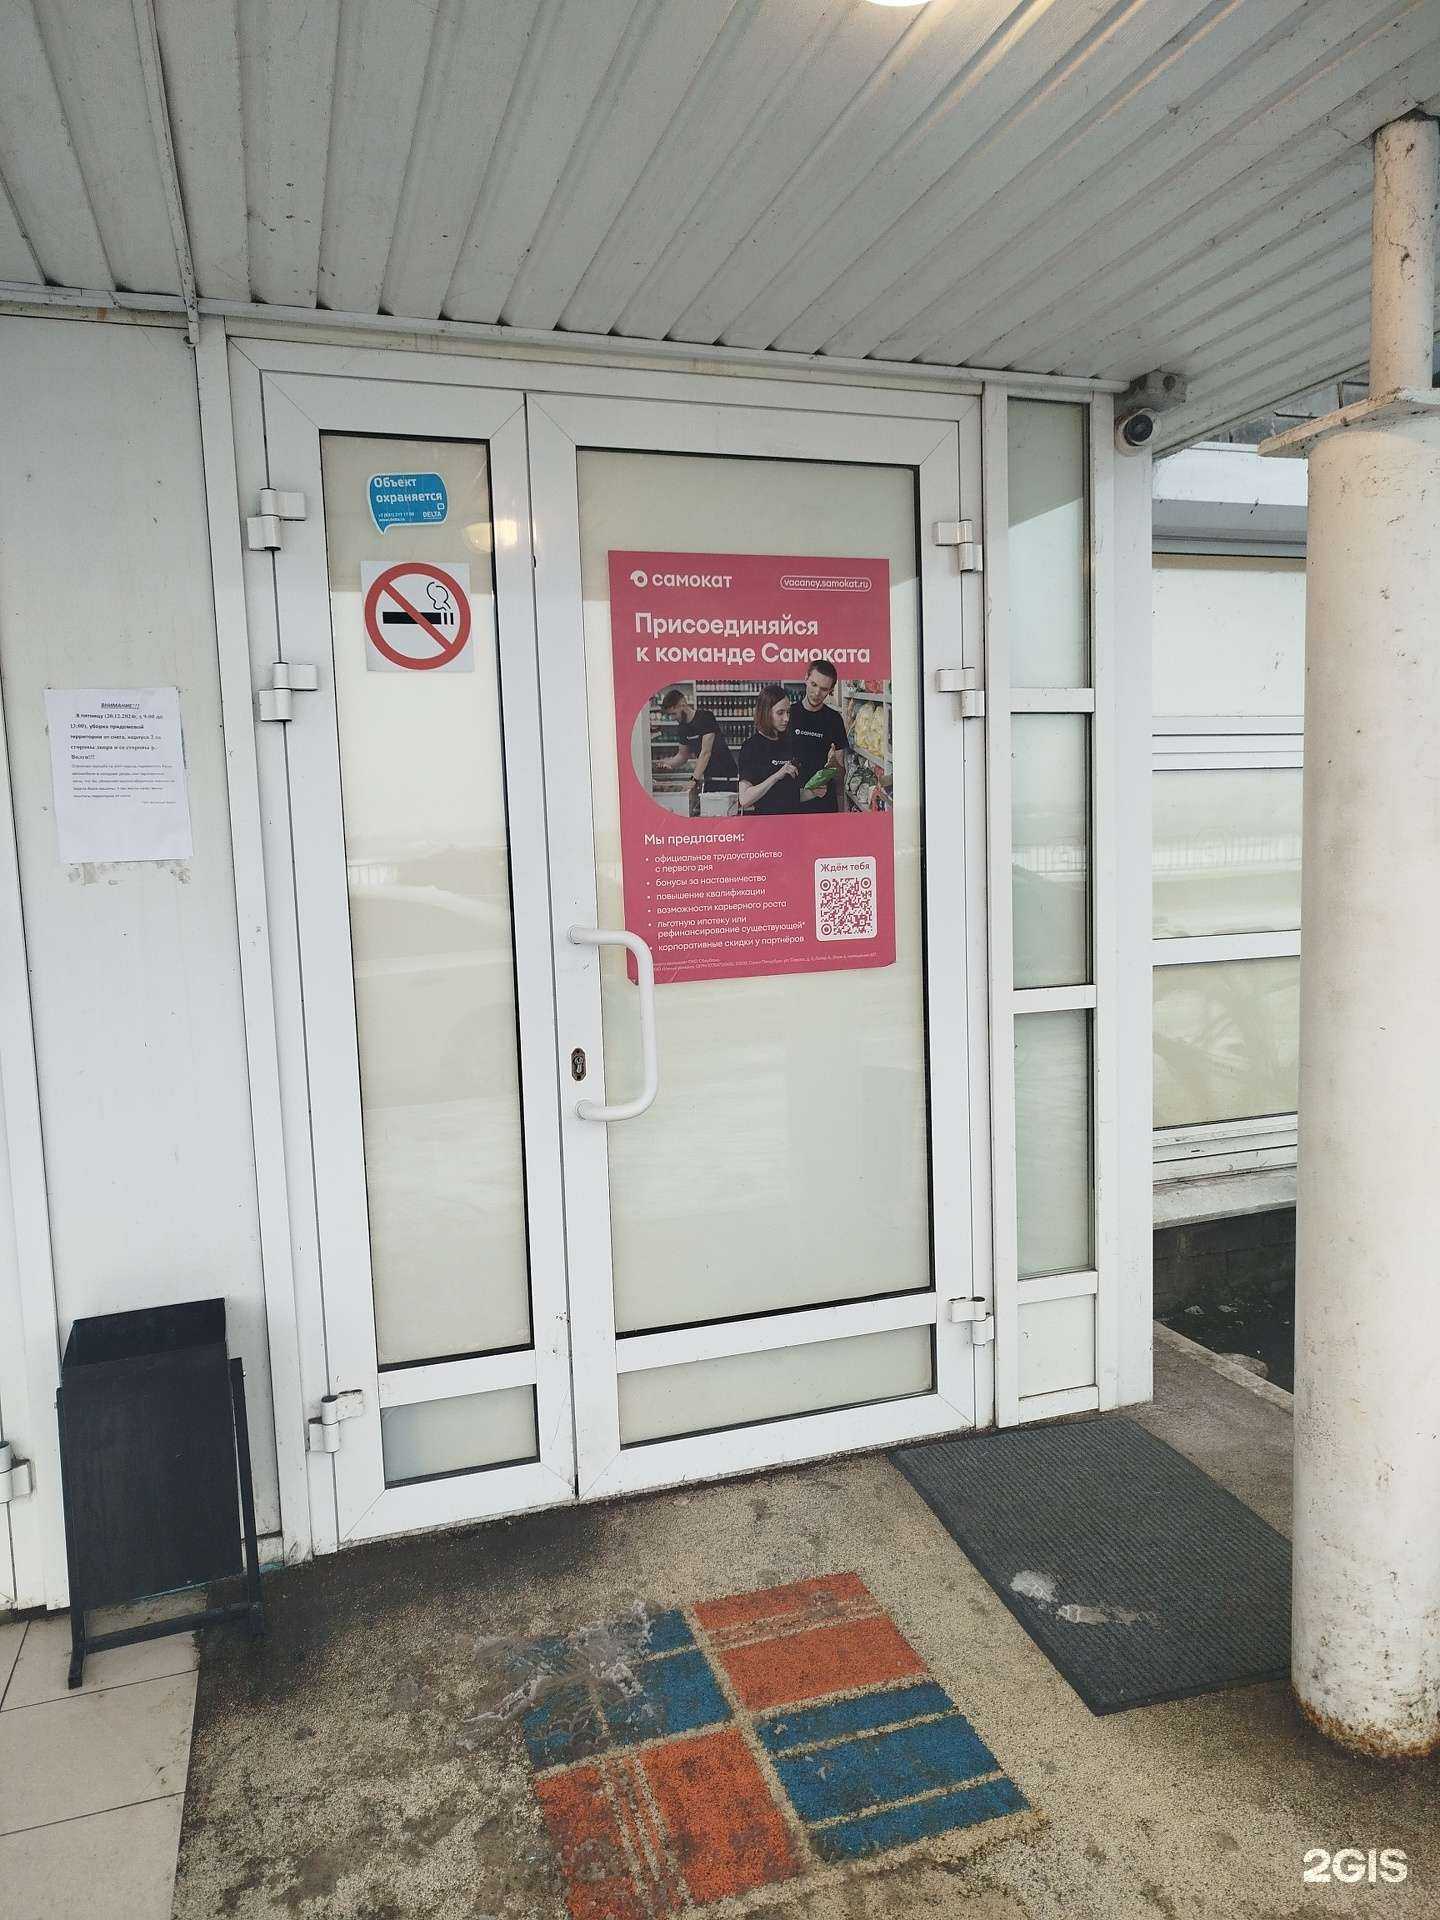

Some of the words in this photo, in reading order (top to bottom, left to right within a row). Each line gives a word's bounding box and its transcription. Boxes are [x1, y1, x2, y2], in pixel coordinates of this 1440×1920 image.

[374, 477, 416, 488] Объект
[376, 493, 442, 504] охраняется
[652, 572, 732, 588] самокат
[784, 579, 869, 589] vacancy.samokat.ru
[635, 613, 818, 638] Присоединяйся
[636, 648, 650, 662] к
[656, 648, 756, 665] команде
[761, 643, 870, 663] Самоката
[644, 834, 664, 845] Мы
[668, 833, 745, 846] предлагаем:
[655, 854, 712, 864] официальное
[713, 850, 783, 861] трудоустройство
[662, 865, 696, 874] первого
[698, 864, 713, 872] дня
[820, 863, 848, 872] Ждём
[849, 861, 870, 871] тебя
[656, 878, 687, 888] бонусы
[700, 875, 767, 885] наставничество
[656, 891, 705, 901] повышение
[706, 887, 766, 899] квалификации
[656, 905, 713, 915] возможности
[714, 902, 762, 912] карьерного
[762, 900, 787, 910] роста
[657, 918, 696, 929] льготную
[697, 918, 730, 926] ипотеку
[731, 915, 747, 924] или
[657, 928, 740, 940] рефинансирование
[658, 940, 723, 952] корпоративные
[724, 938, 753, 947] скидки
[761, 935, 805, 946] партнёров
